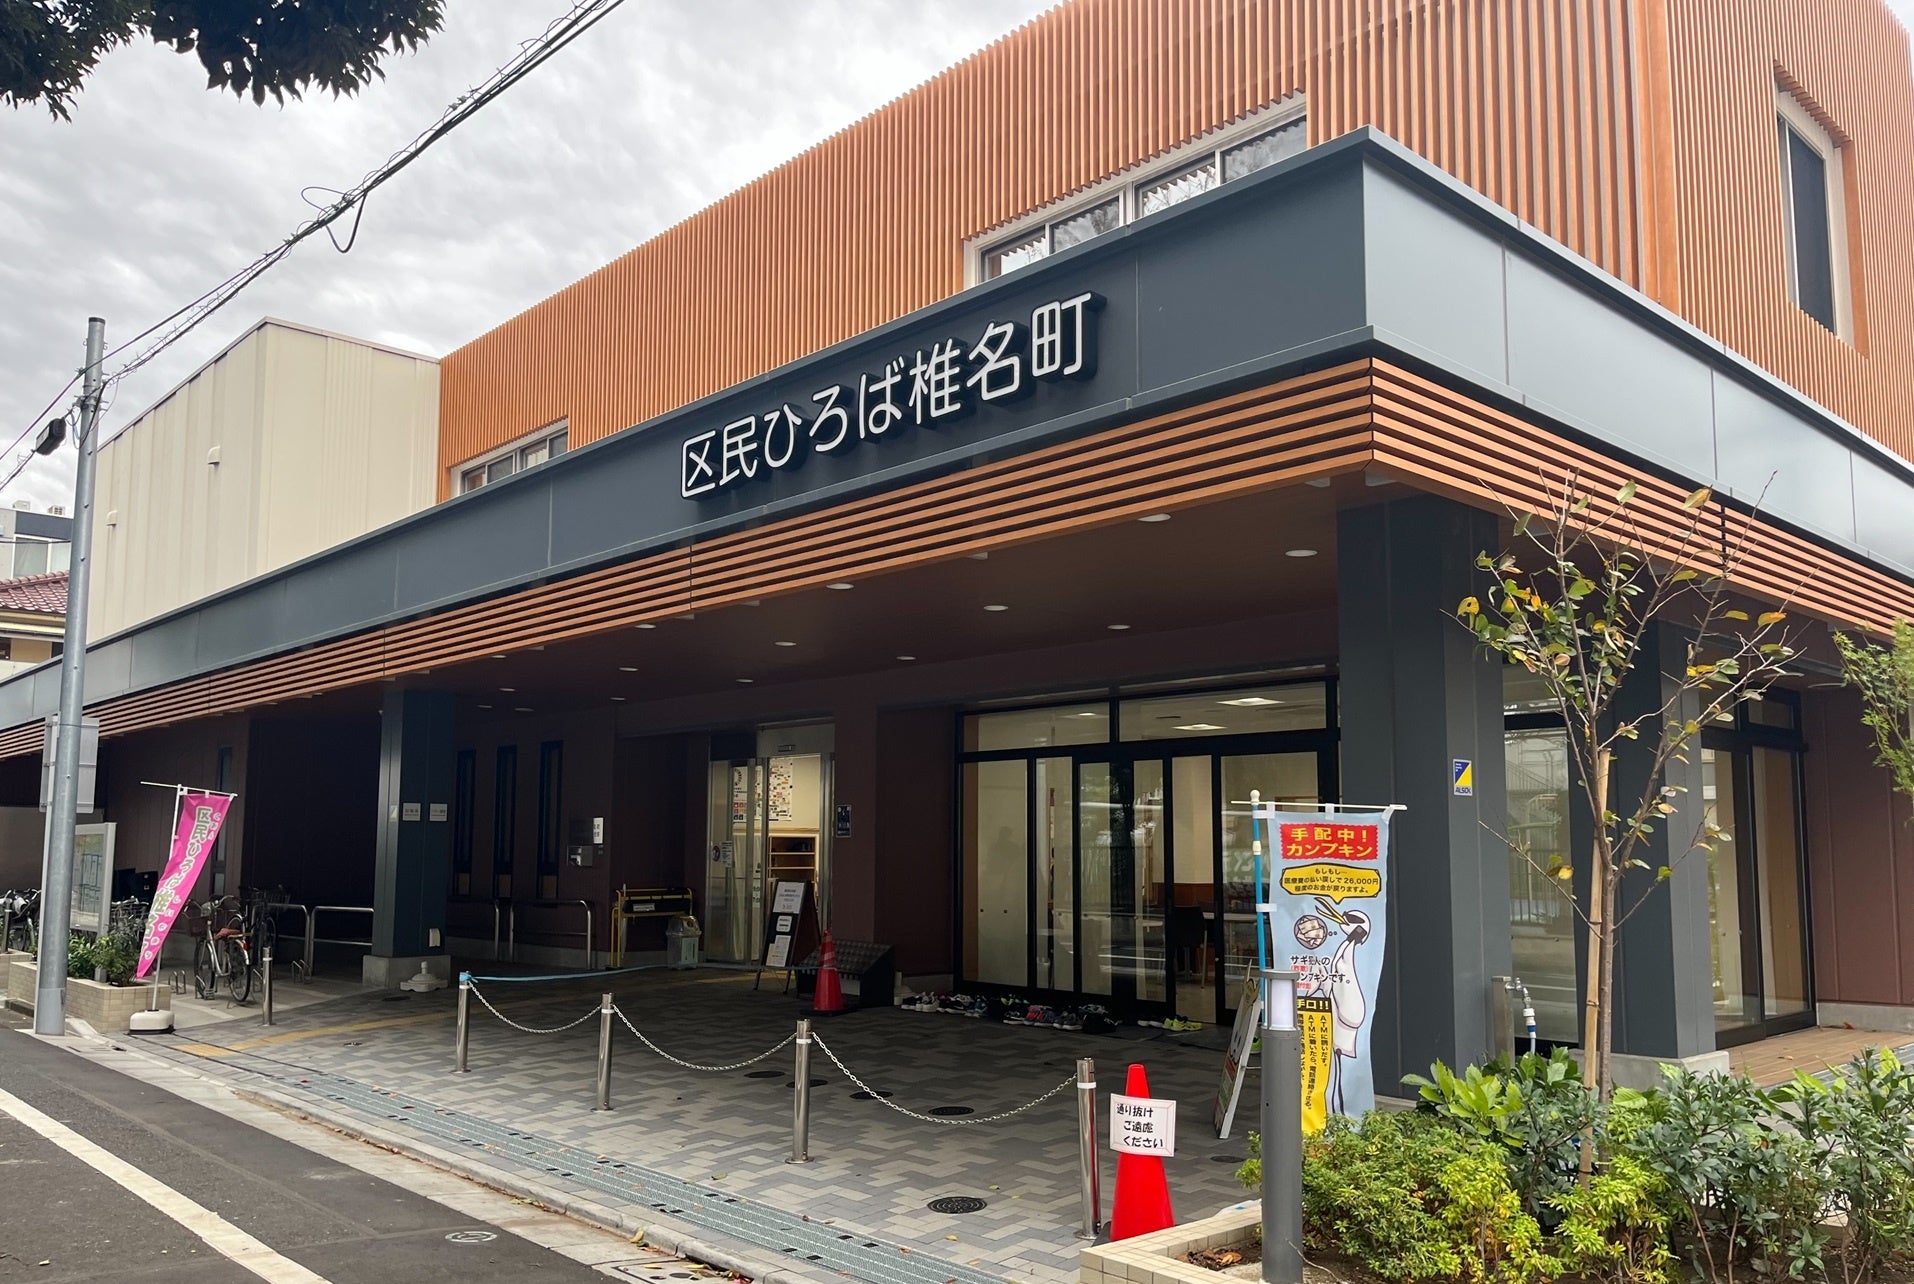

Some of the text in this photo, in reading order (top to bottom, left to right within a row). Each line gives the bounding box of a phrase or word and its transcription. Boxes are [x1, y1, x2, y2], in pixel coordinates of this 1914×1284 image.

[681, 290, 1092, 498] 区民ひろば椎名町
[1290, 826, 1368, 843] 手配中！
[1286, 842, 1373, 858] カンプキン
[1116, 1103, 1154, 1118] 通り抜け
[1123, 1120, 1154, 1133] ご遠慮
[1123, 1136, 1163, 1148] ください
